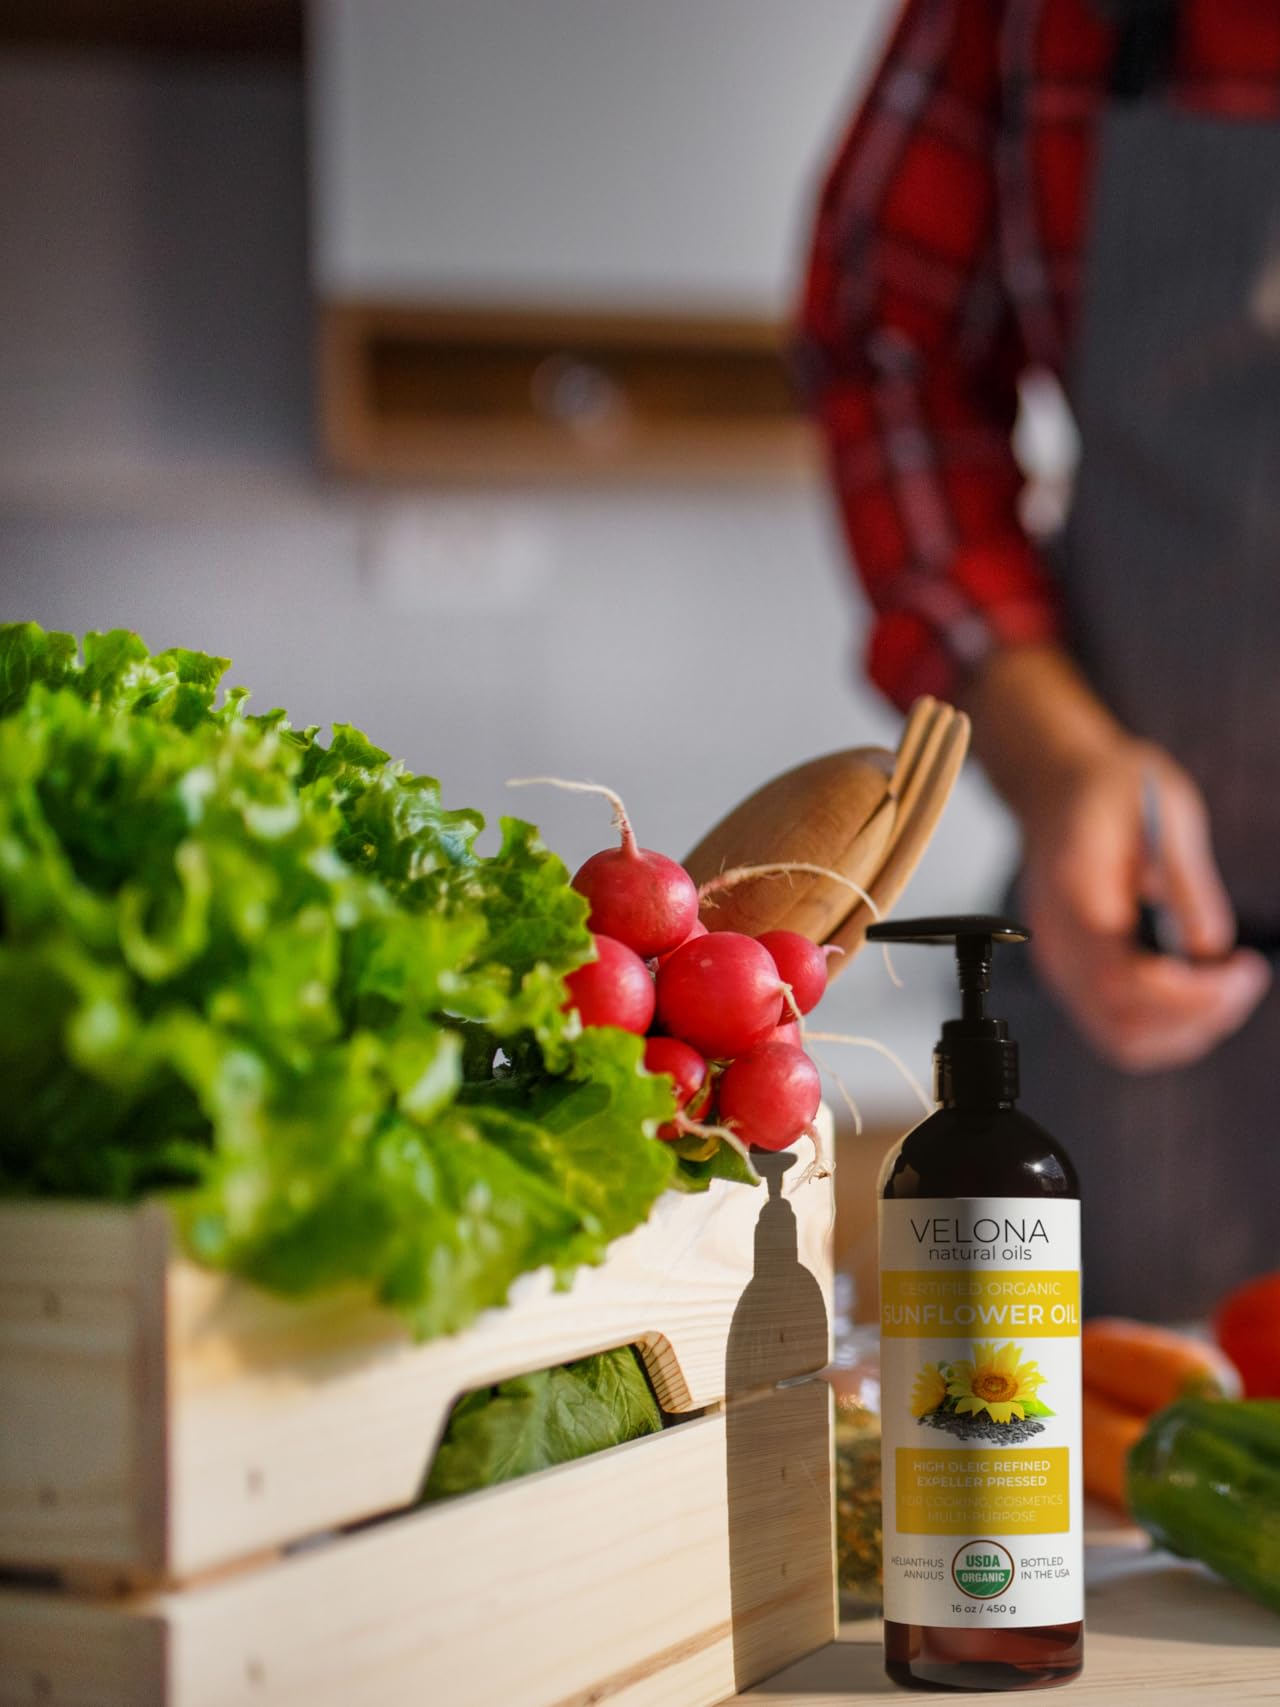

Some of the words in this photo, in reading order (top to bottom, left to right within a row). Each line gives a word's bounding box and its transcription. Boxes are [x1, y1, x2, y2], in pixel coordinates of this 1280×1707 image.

[910, 1218, 1049, 1243] VELONA
[929, 1245, 996, 1261] natural
[1002, 1245, 1032, 1261] oils
[900, 1281, 982, 1296] CERTIFIED
[987, 1281, 1062, 1296] ORGANIC
[884, 1303, 1045, 1326] SUNFLOWER
[1050, 1303, 1077, 1324] OIL
[913, 1461, 944, 1473] HIGH
[948, 1461, 991, 1473] OLEIC
[993, 1460, 1051, 1473] REFINED
[917, 1476, 983, 1488] EXPELLER
[987, 1475, 1047, 1488] PRESSED
[965, 1554, 1000, 1567] USDA
[1020, 1556, 1063, 1567] BOTTLED
[904, 1570, 944, 1580] ANNUUS
[961, 1572, 1005, 1583] ORGANIC
[1020, 1570, 1032, 1580] IN
[1034, 1569, 1052, 1580] THE
[1054, 1568, 1070, 1578] USA
[951, 1604, 962, 1613] 16
[964, 1606, 977, 1614] oz
[986, 1604, 1007, 1613] 450
[1009, 1606, 1016, 1615] g
